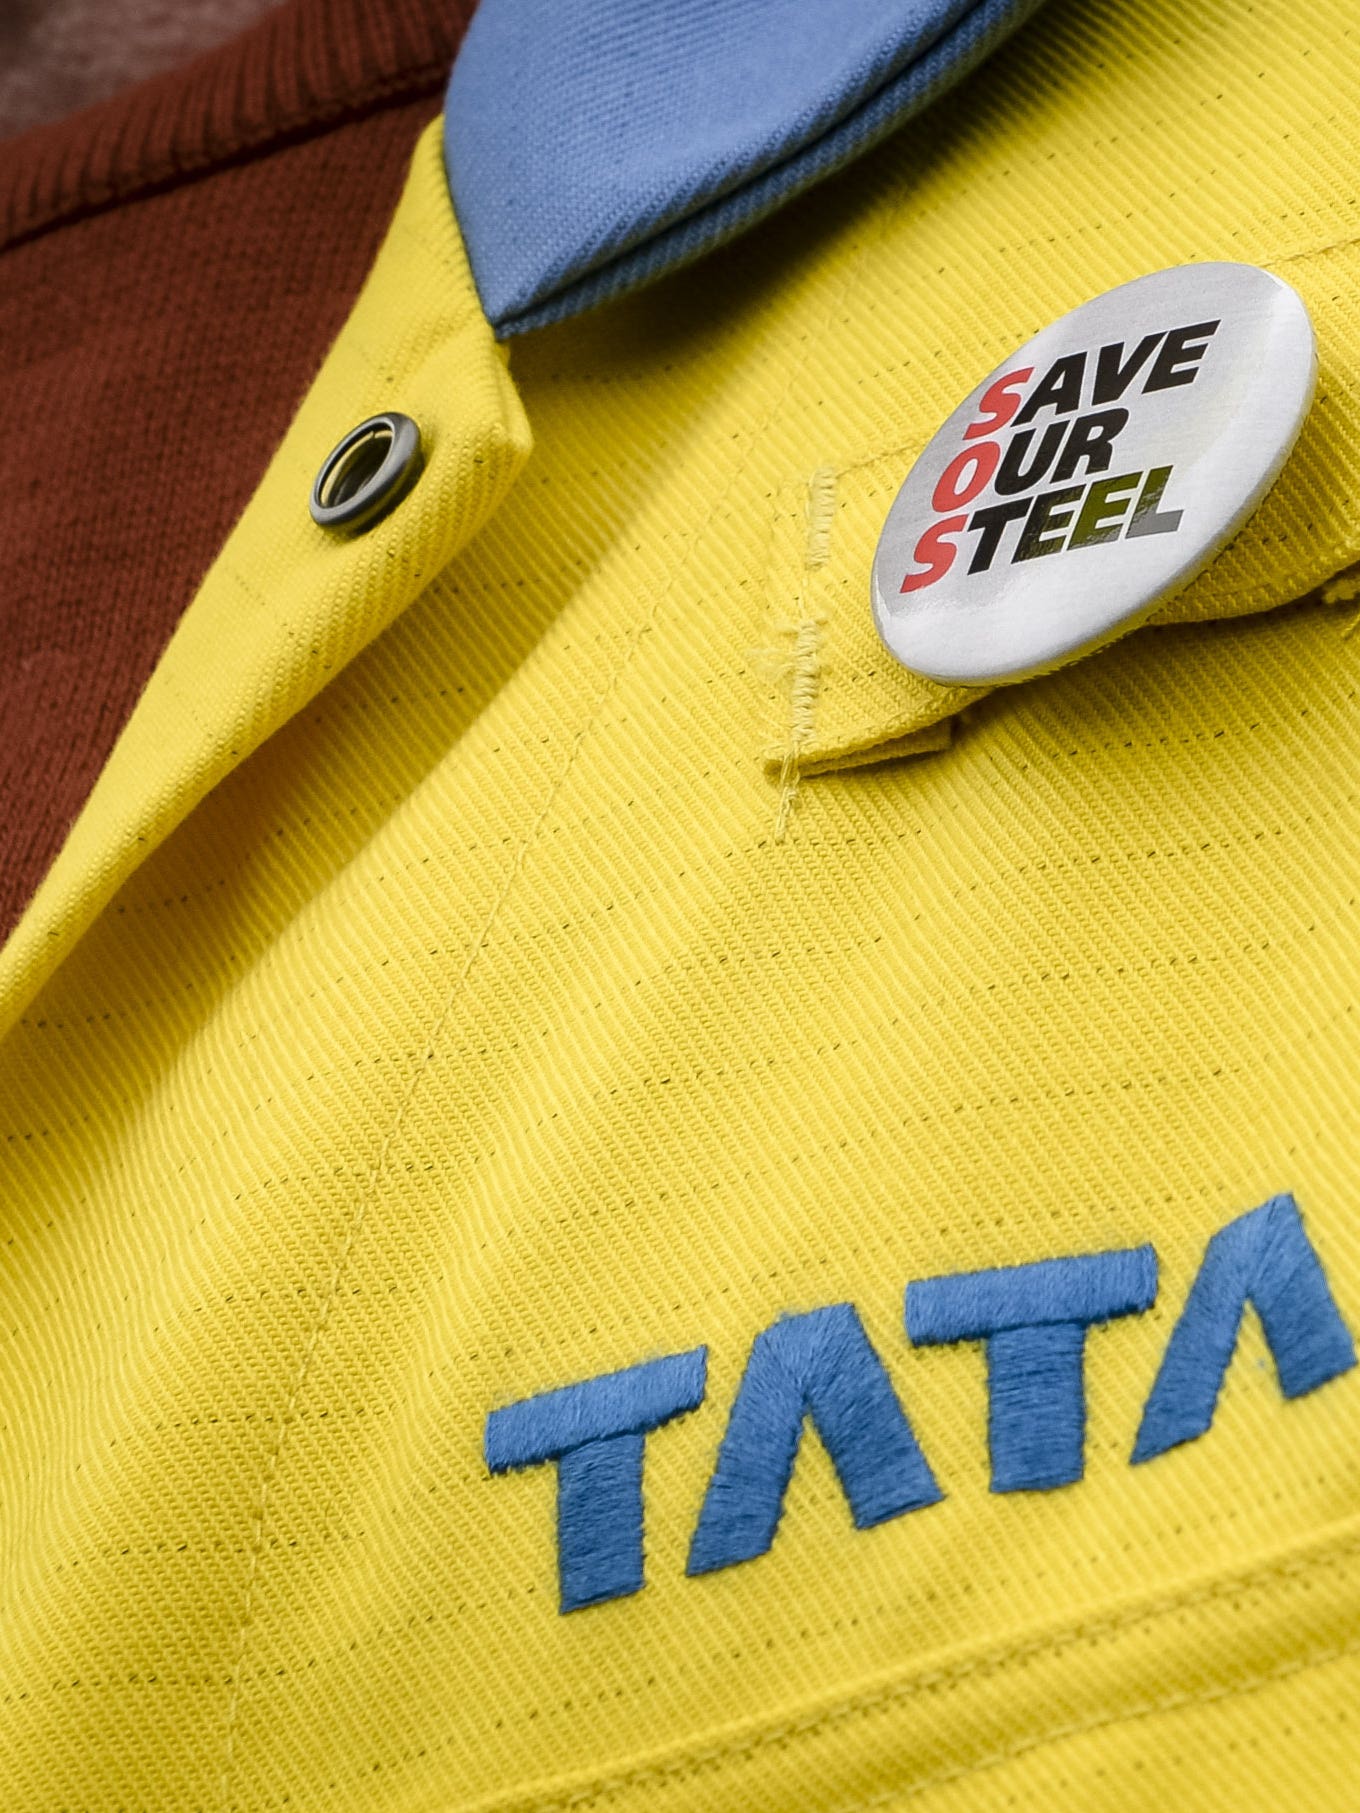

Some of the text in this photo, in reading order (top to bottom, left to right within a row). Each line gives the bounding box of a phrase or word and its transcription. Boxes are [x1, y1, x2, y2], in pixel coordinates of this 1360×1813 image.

[962, 318, 1222, 441] SAVE
[930, 407, 1130, 513] OUR
[899, 464, 1185, 594] STEEL
[483, 1191, 1360, 1617] TATA
